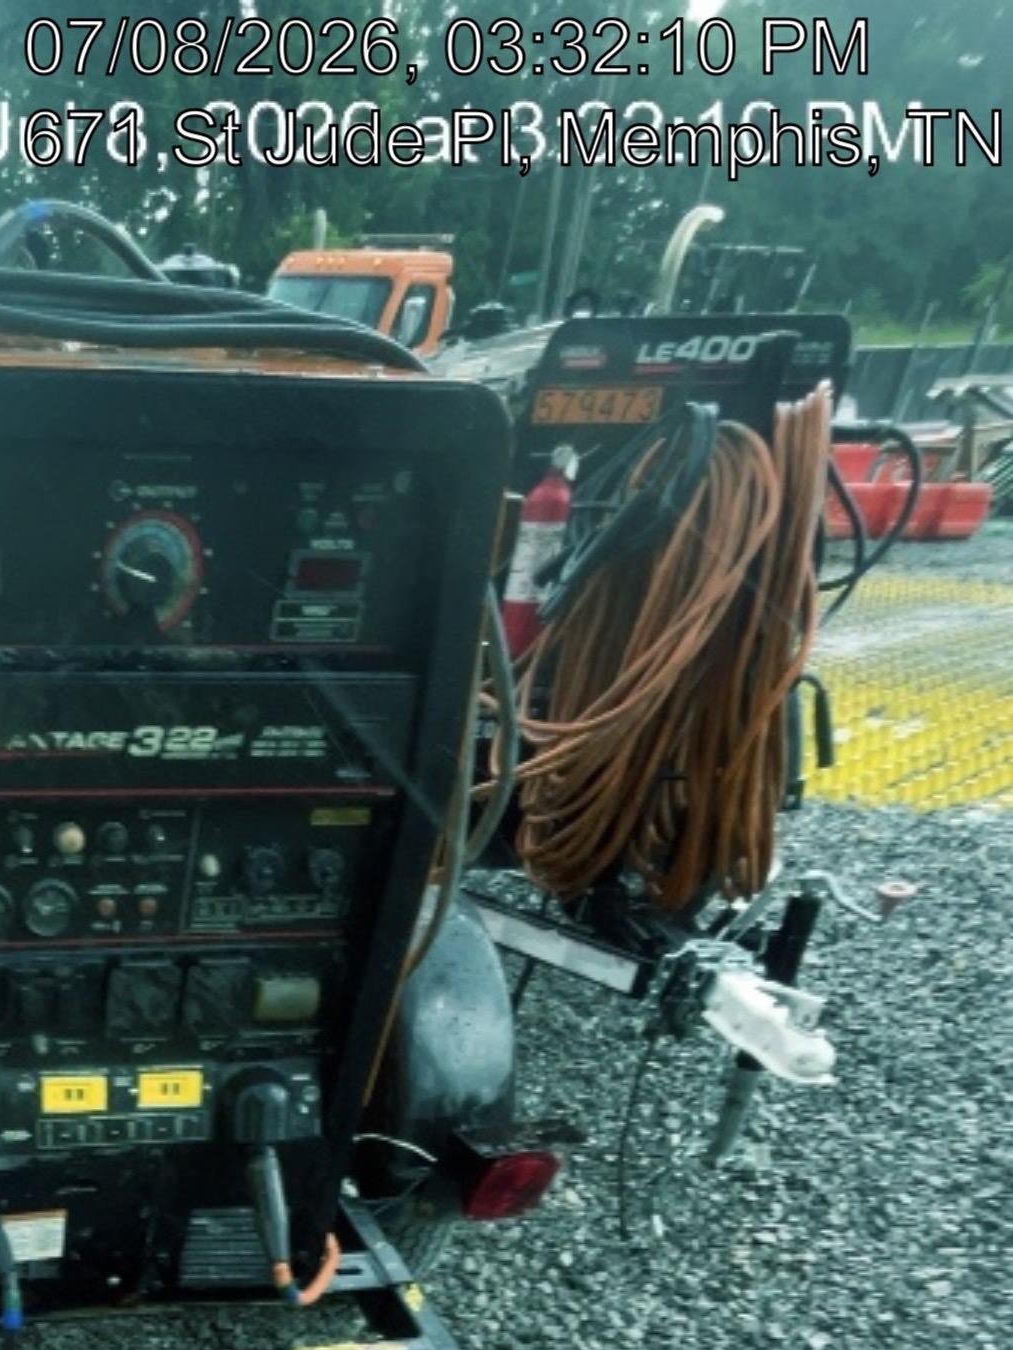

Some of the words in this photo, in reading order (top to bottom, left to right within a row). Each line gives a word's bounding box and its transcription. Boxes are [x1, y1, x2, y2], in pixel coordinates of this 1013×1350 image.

[635, 334, 758, 365] LE400
[6, 730, 128, 750] ATAGE
[127, 725, 219, 757] 322
